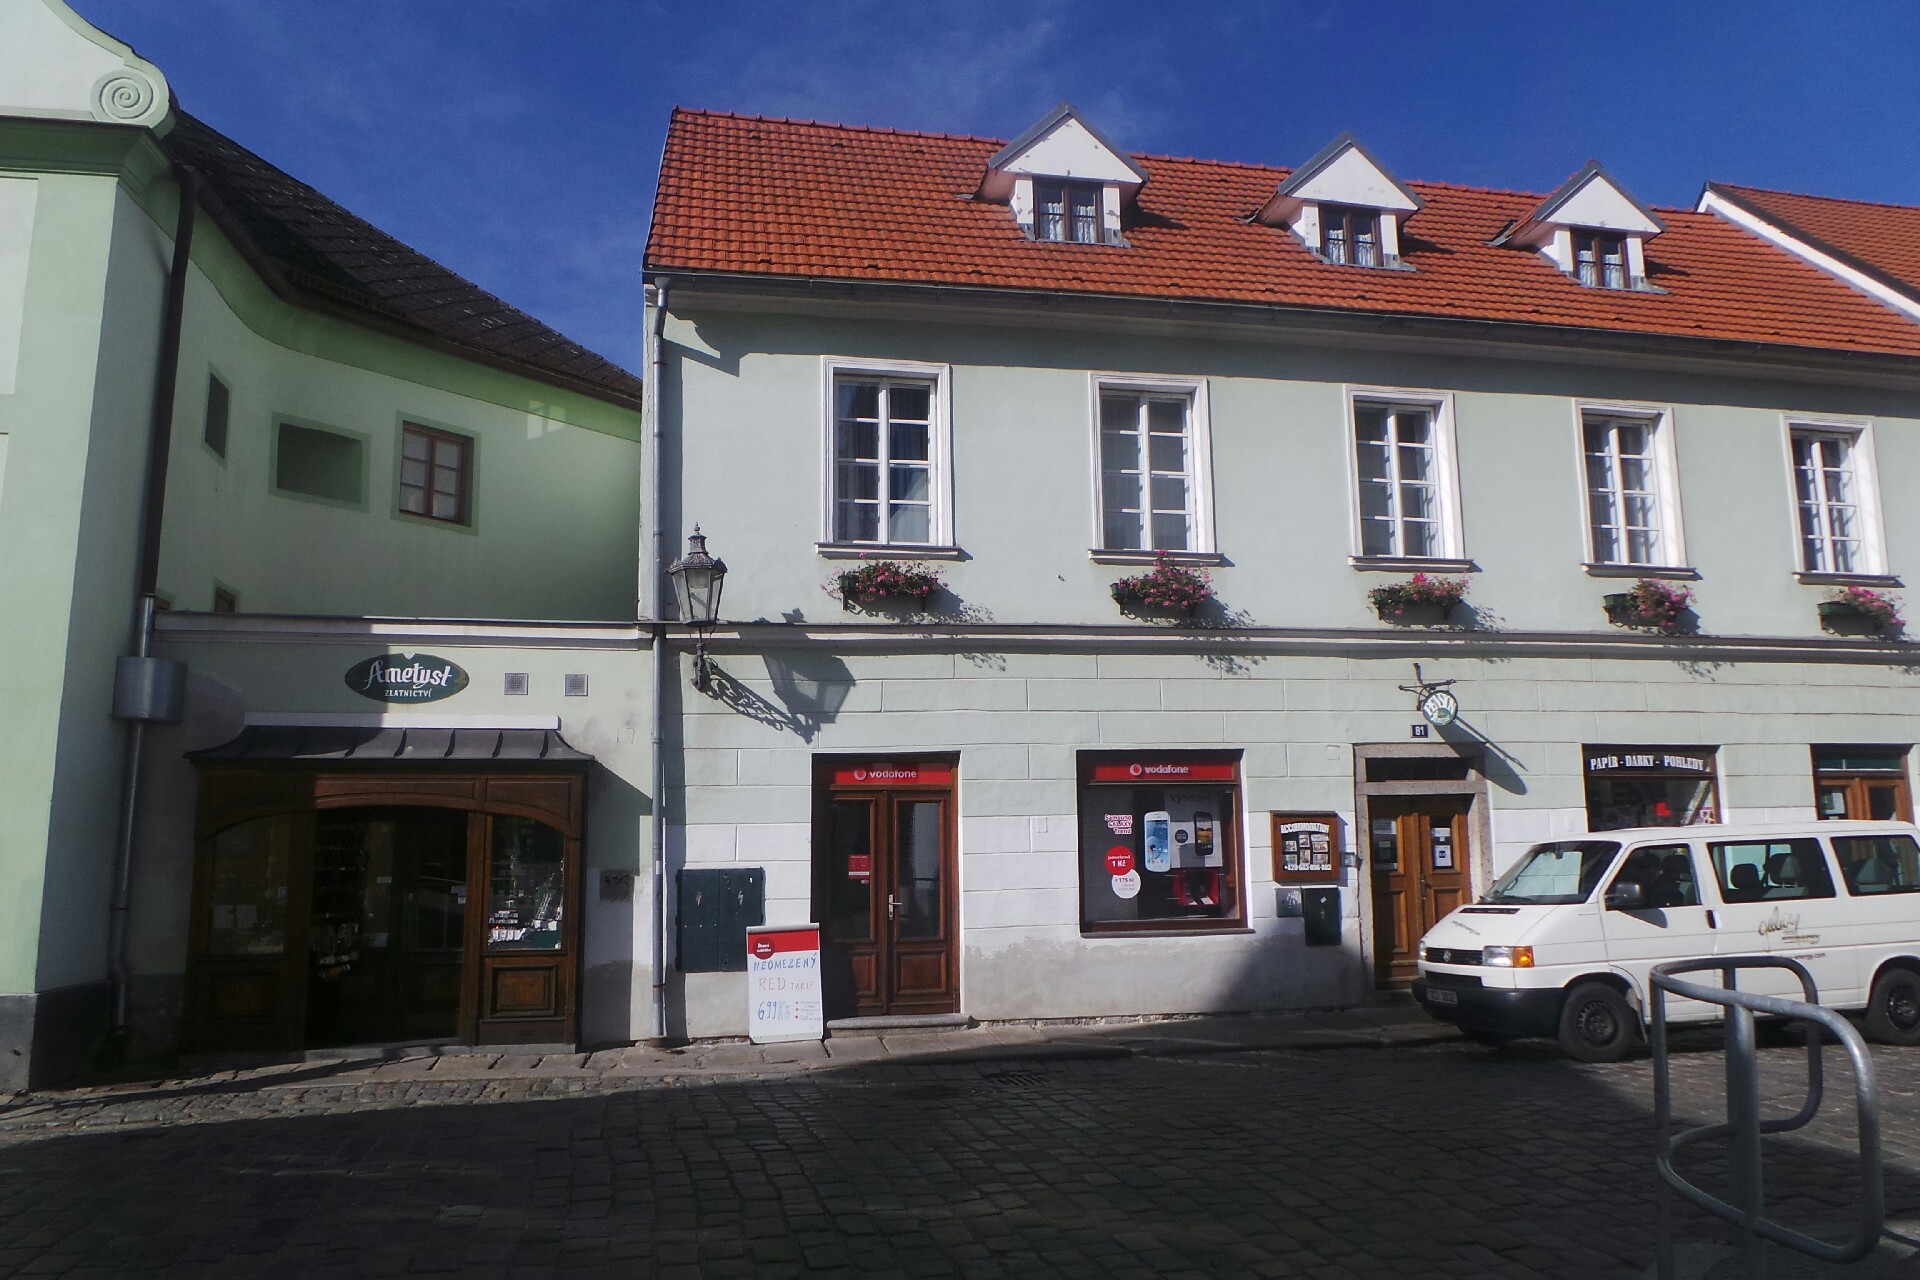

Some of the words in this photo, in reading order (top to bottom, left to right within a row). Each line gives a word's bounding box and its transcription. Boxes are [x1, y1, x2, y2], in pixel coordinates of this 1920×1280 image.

[362, 660, 452, 690] Ametyst
[384, 689, 432, 698] ZLATNICTVÍ
[1414, 725, 1424, 736] 81
[1590, 755, 1618, 770] PAPÍR
[1663, 755, 1704, 771] POHLEDY
[869, 770, 917, 779] vodafone
[1144, 765, 1190, 775] vodafone
[1105, 814, 1132, 822] Samsung
[753, 953, 817, 971] NEOMEZENÝ
[758, 977, 786, 992] RED
[791, 982, 814, 990] TARIF
[757, 1001, 777, 1020] 699
